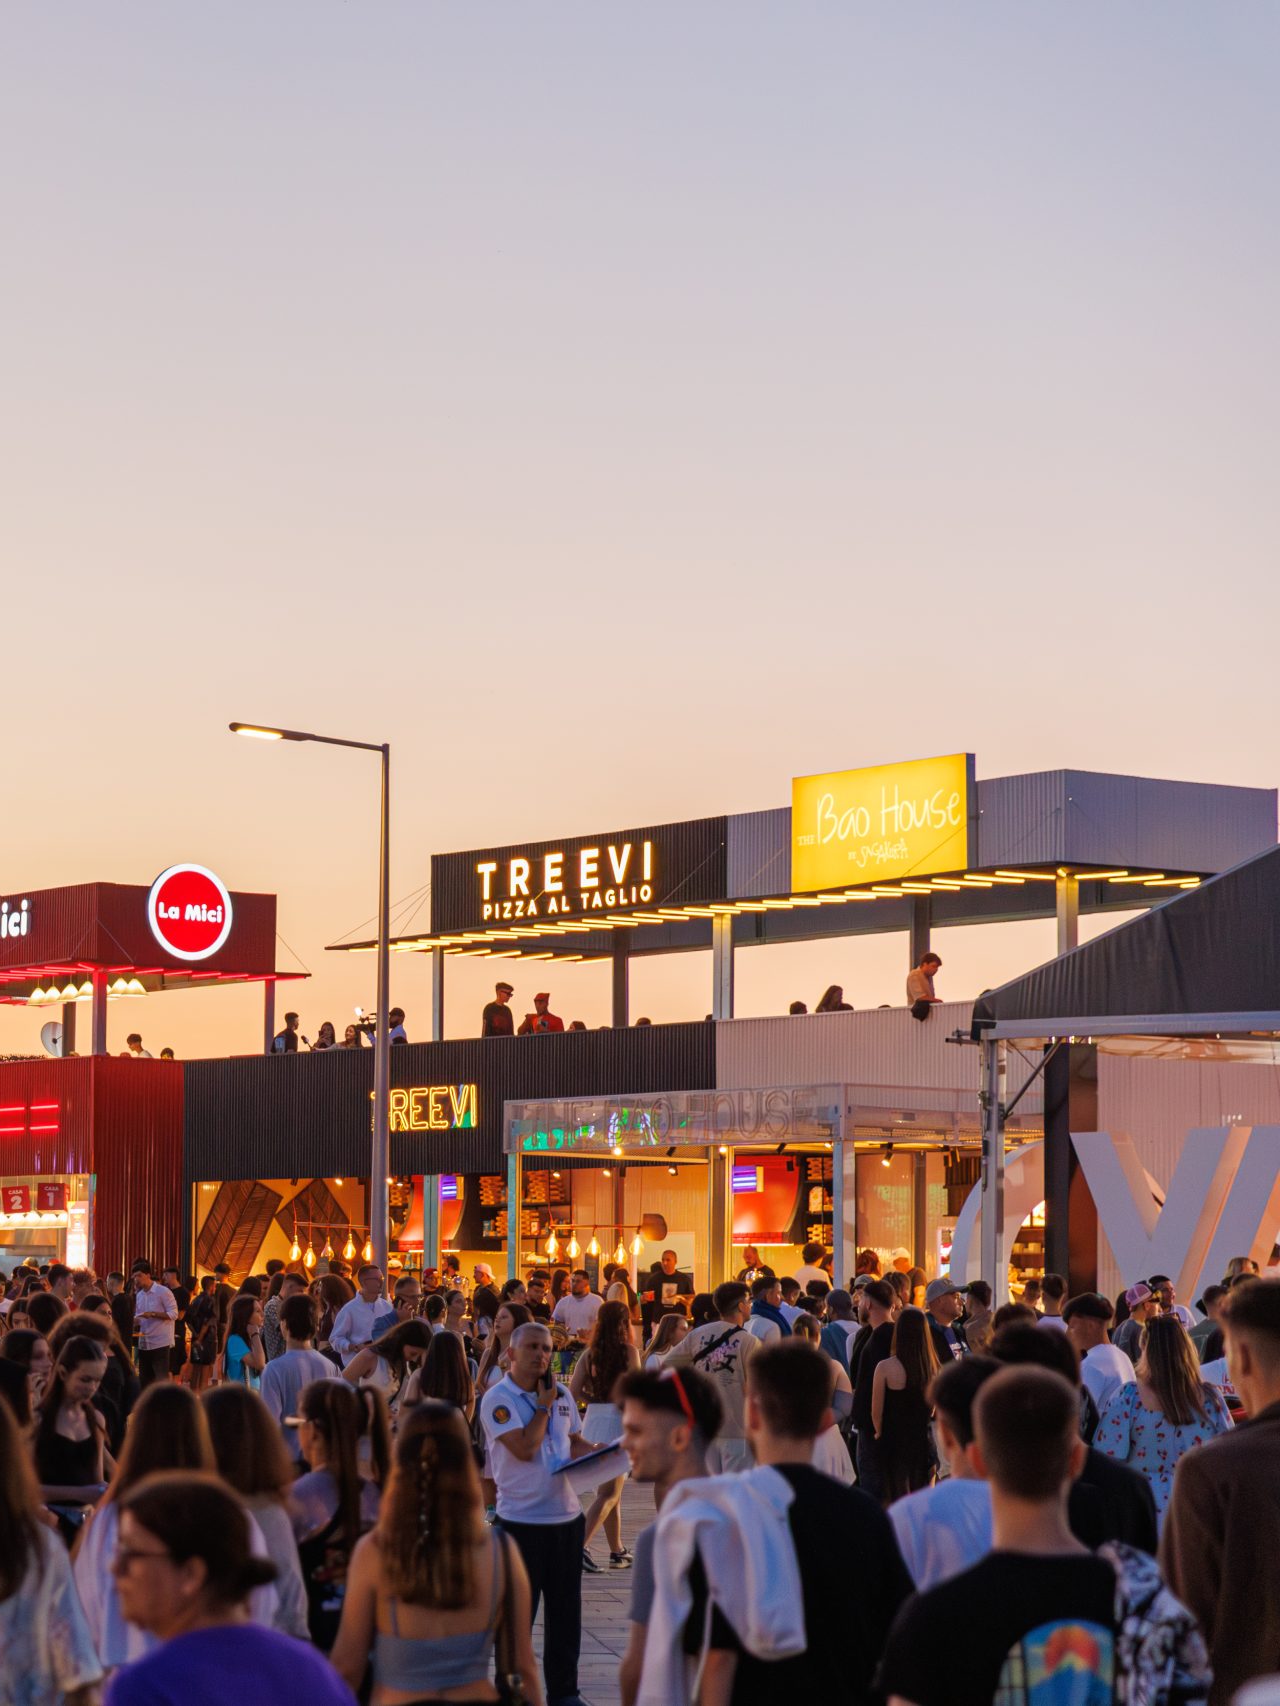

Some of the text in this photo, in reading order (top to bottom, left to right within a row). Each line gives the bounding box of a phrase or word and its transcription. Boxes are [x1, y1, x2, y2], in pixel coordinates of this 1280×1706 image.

[817, 793, 870, 845] Bao
[880, 784, 961, 837] House
[477, 841, 652, 900] TREEVI
[158, 901, 223, 924] La Mici
[483, 885, 652, 920] PIZZA AL TAGLIO
[10, 1195, 23, 1210] 2
[46, 1192, 55, 1206] 1
